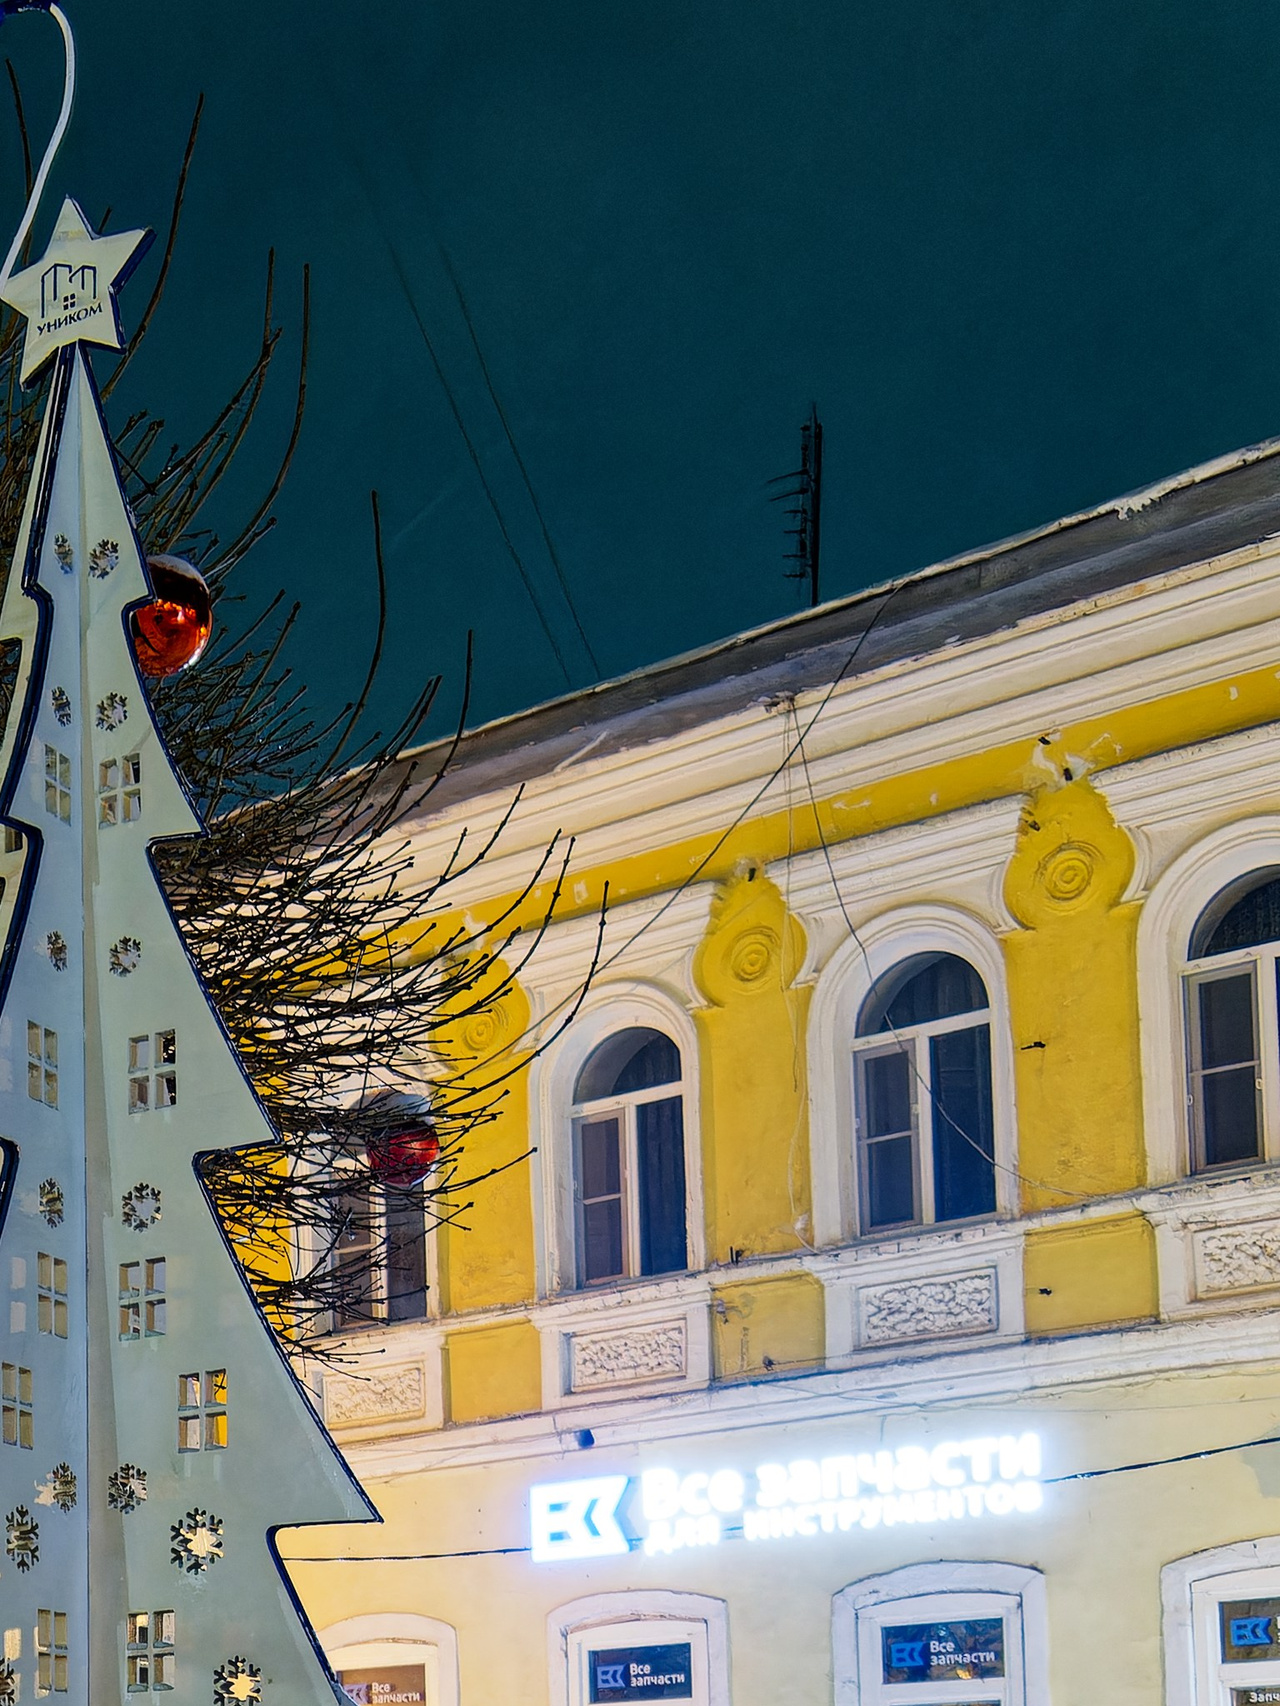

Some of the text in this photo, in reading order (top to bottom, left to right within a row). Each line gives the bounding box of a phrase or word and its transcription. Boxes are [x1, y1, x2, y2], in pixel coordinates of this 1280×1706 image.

[36, 301, 103, 336] УНИКОМ
[641, 1432, 1042, 1521] Все запчасти
[929, 1640, 955, 1653] Все
[930, 1651, 995, 1666] запчасти
[629, 1662, 651, 1675] Все
[630, 1673, 685, 1688] запчасти
[371, 1682, 391, 1694] Все
[372, 1692, 420, 1704] запчасти
